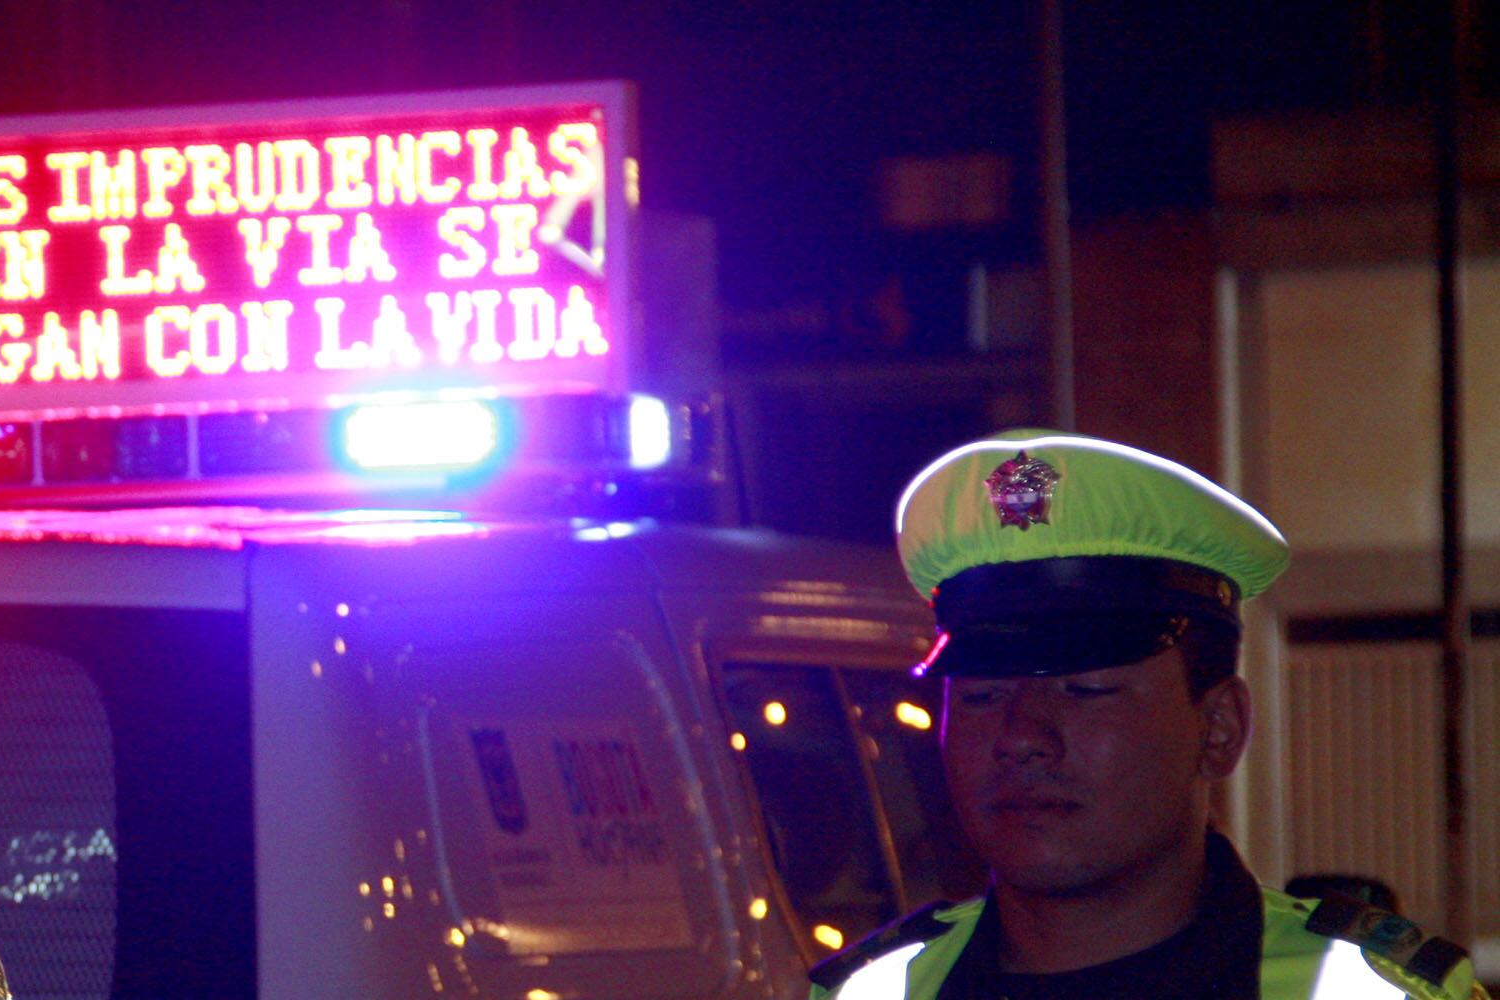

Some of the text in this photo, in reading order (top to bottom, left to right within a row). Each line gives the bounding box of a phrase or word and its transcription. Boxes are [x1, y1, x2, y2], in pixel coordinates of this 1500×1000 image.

[47, 123, 599, 223] IMPRUDENCIAS
[100, 223, 206, 295] LA
[238, 212, 397, 288] VIA
[438, 203, 541, 279] SE
[145, 300, 293, 376] CON
